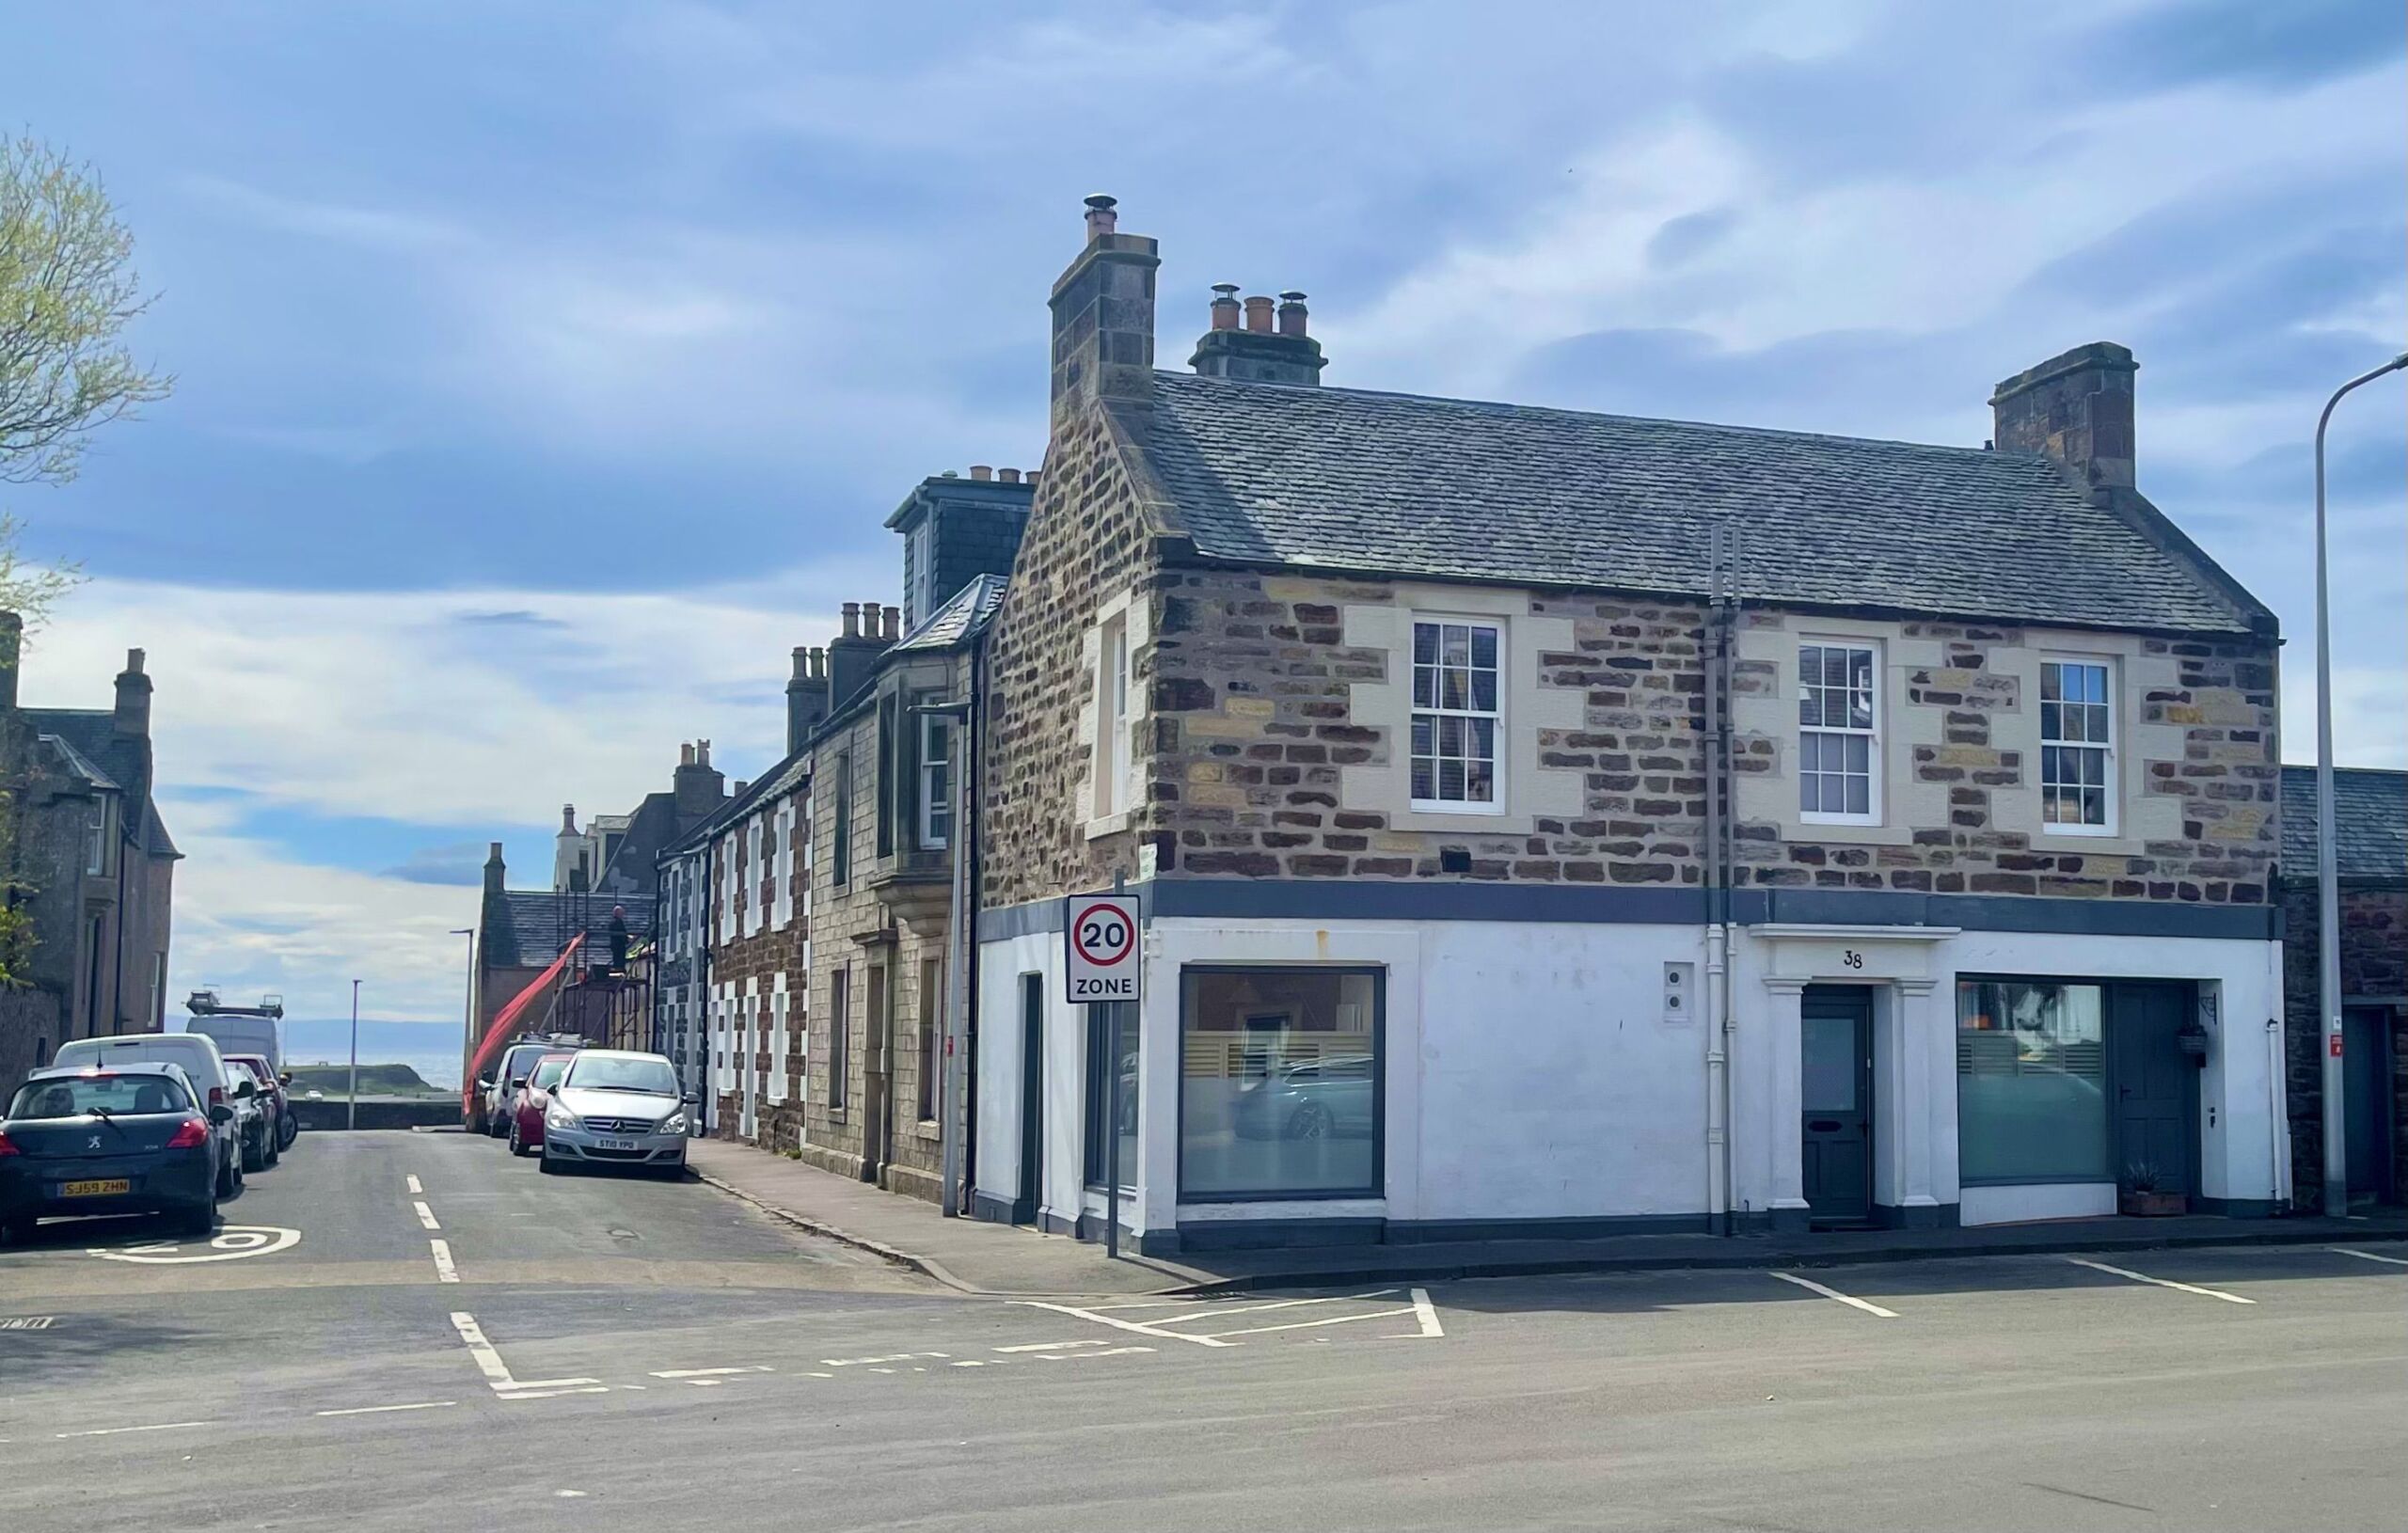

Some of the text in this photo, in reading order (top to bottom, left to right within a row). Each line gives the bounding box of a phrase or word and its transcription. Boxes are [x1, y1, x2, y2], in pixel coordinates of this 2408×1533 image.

[1084, 923, 1125, 948] 20
[1844, 950, 1862, 969] 38
[1076, 978, 1133, 994] ZONE
[65, 1180, 129, 1195] SJ59 ZHN
